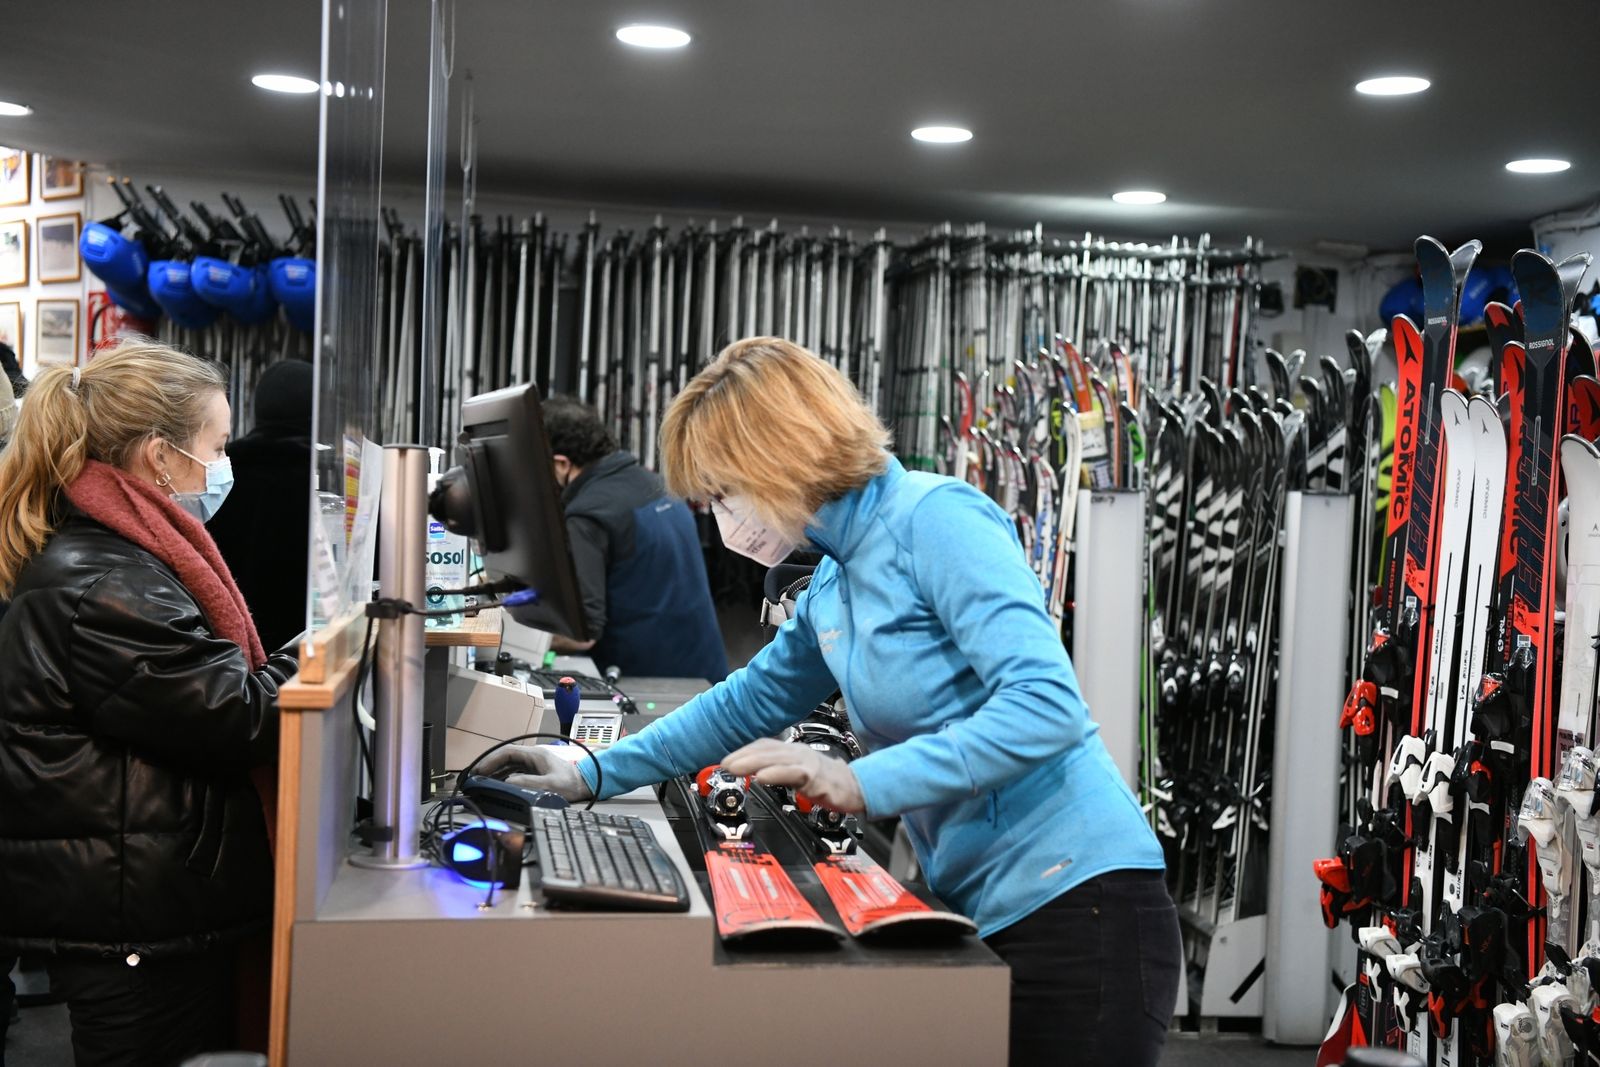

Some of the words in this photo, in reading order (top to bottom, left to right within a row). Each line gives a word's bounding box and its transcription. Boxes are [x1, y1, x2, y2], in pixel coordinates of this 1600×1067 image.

[1528, 338, 1555, 350] ROSSIGNOL
[1393, 378, 1417, 520] ATOMIC
[1482, 478, 1490, 519] ATOMIC
[1387, 561, 1395, 608] REDSTER
[1503, 604, 1512, 661] REDSTER
